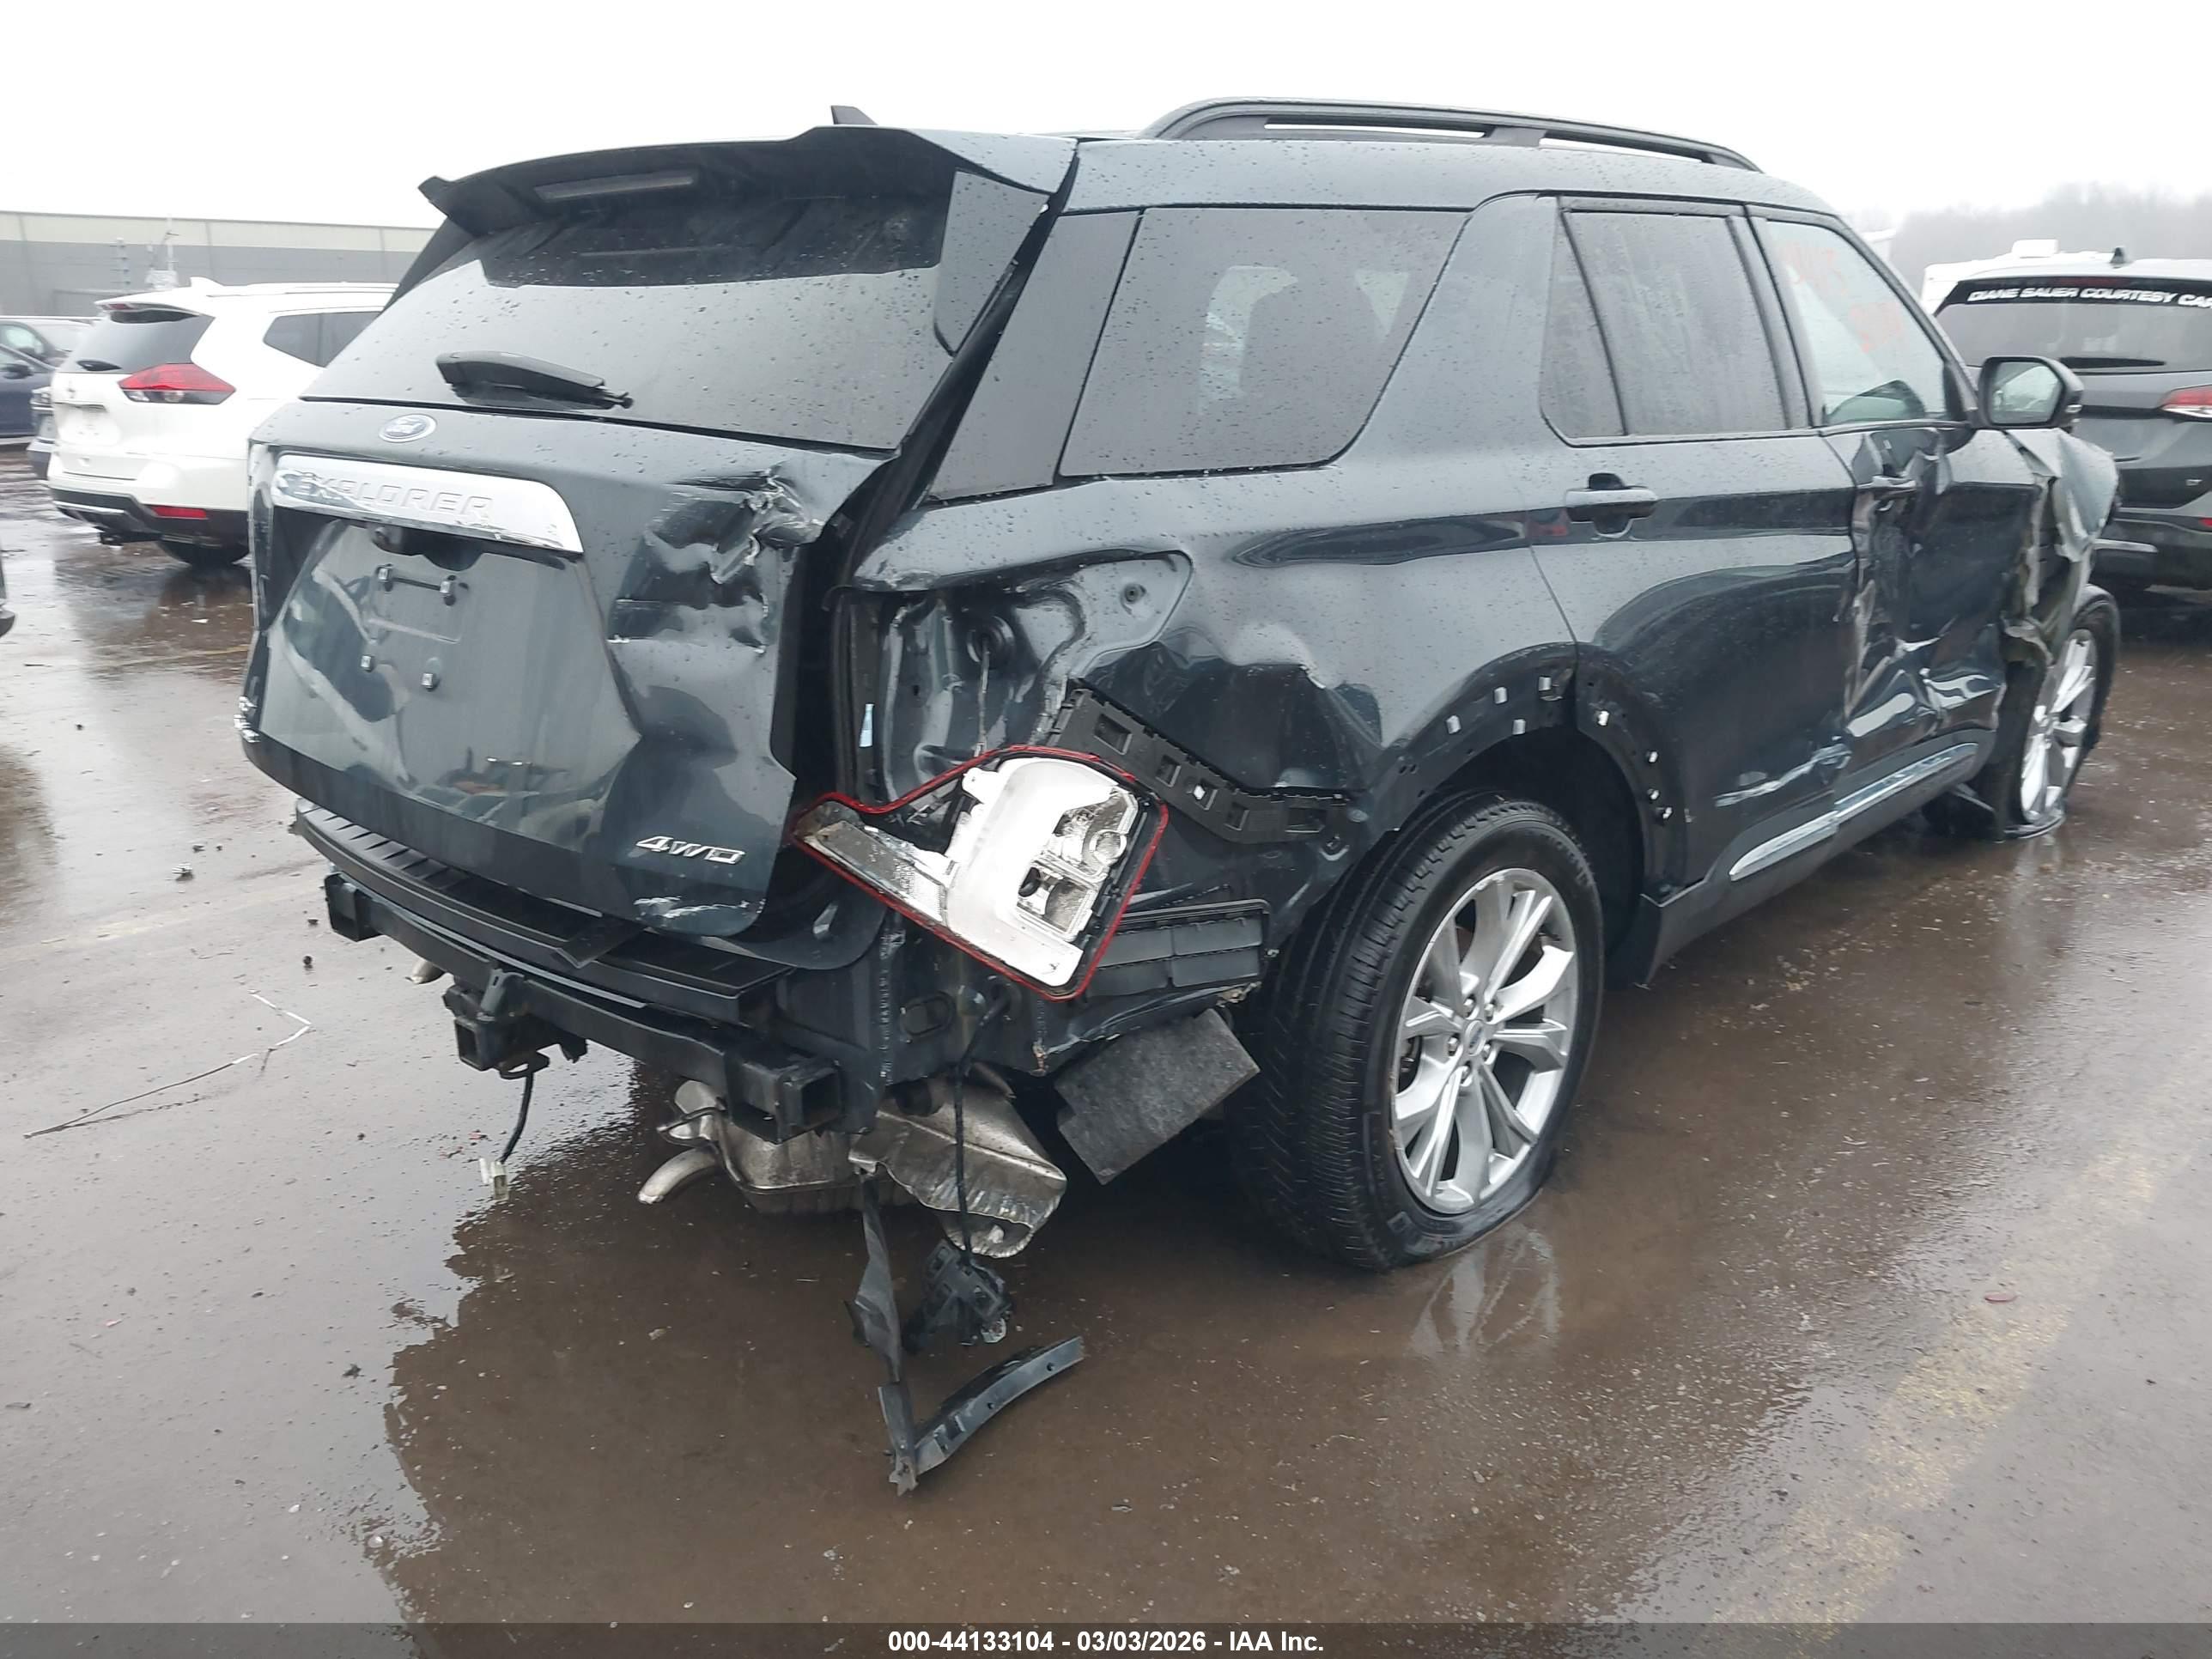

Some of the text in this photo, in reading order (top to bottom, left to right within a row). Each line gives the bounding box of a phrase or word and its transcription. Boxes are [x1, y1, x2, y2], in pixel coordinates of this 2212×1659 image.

[2019, 287, 2080, 298] SAUER
[2079, 288, 2179, 303] COURTESY
[635, 835, 746, 865] 4WD
